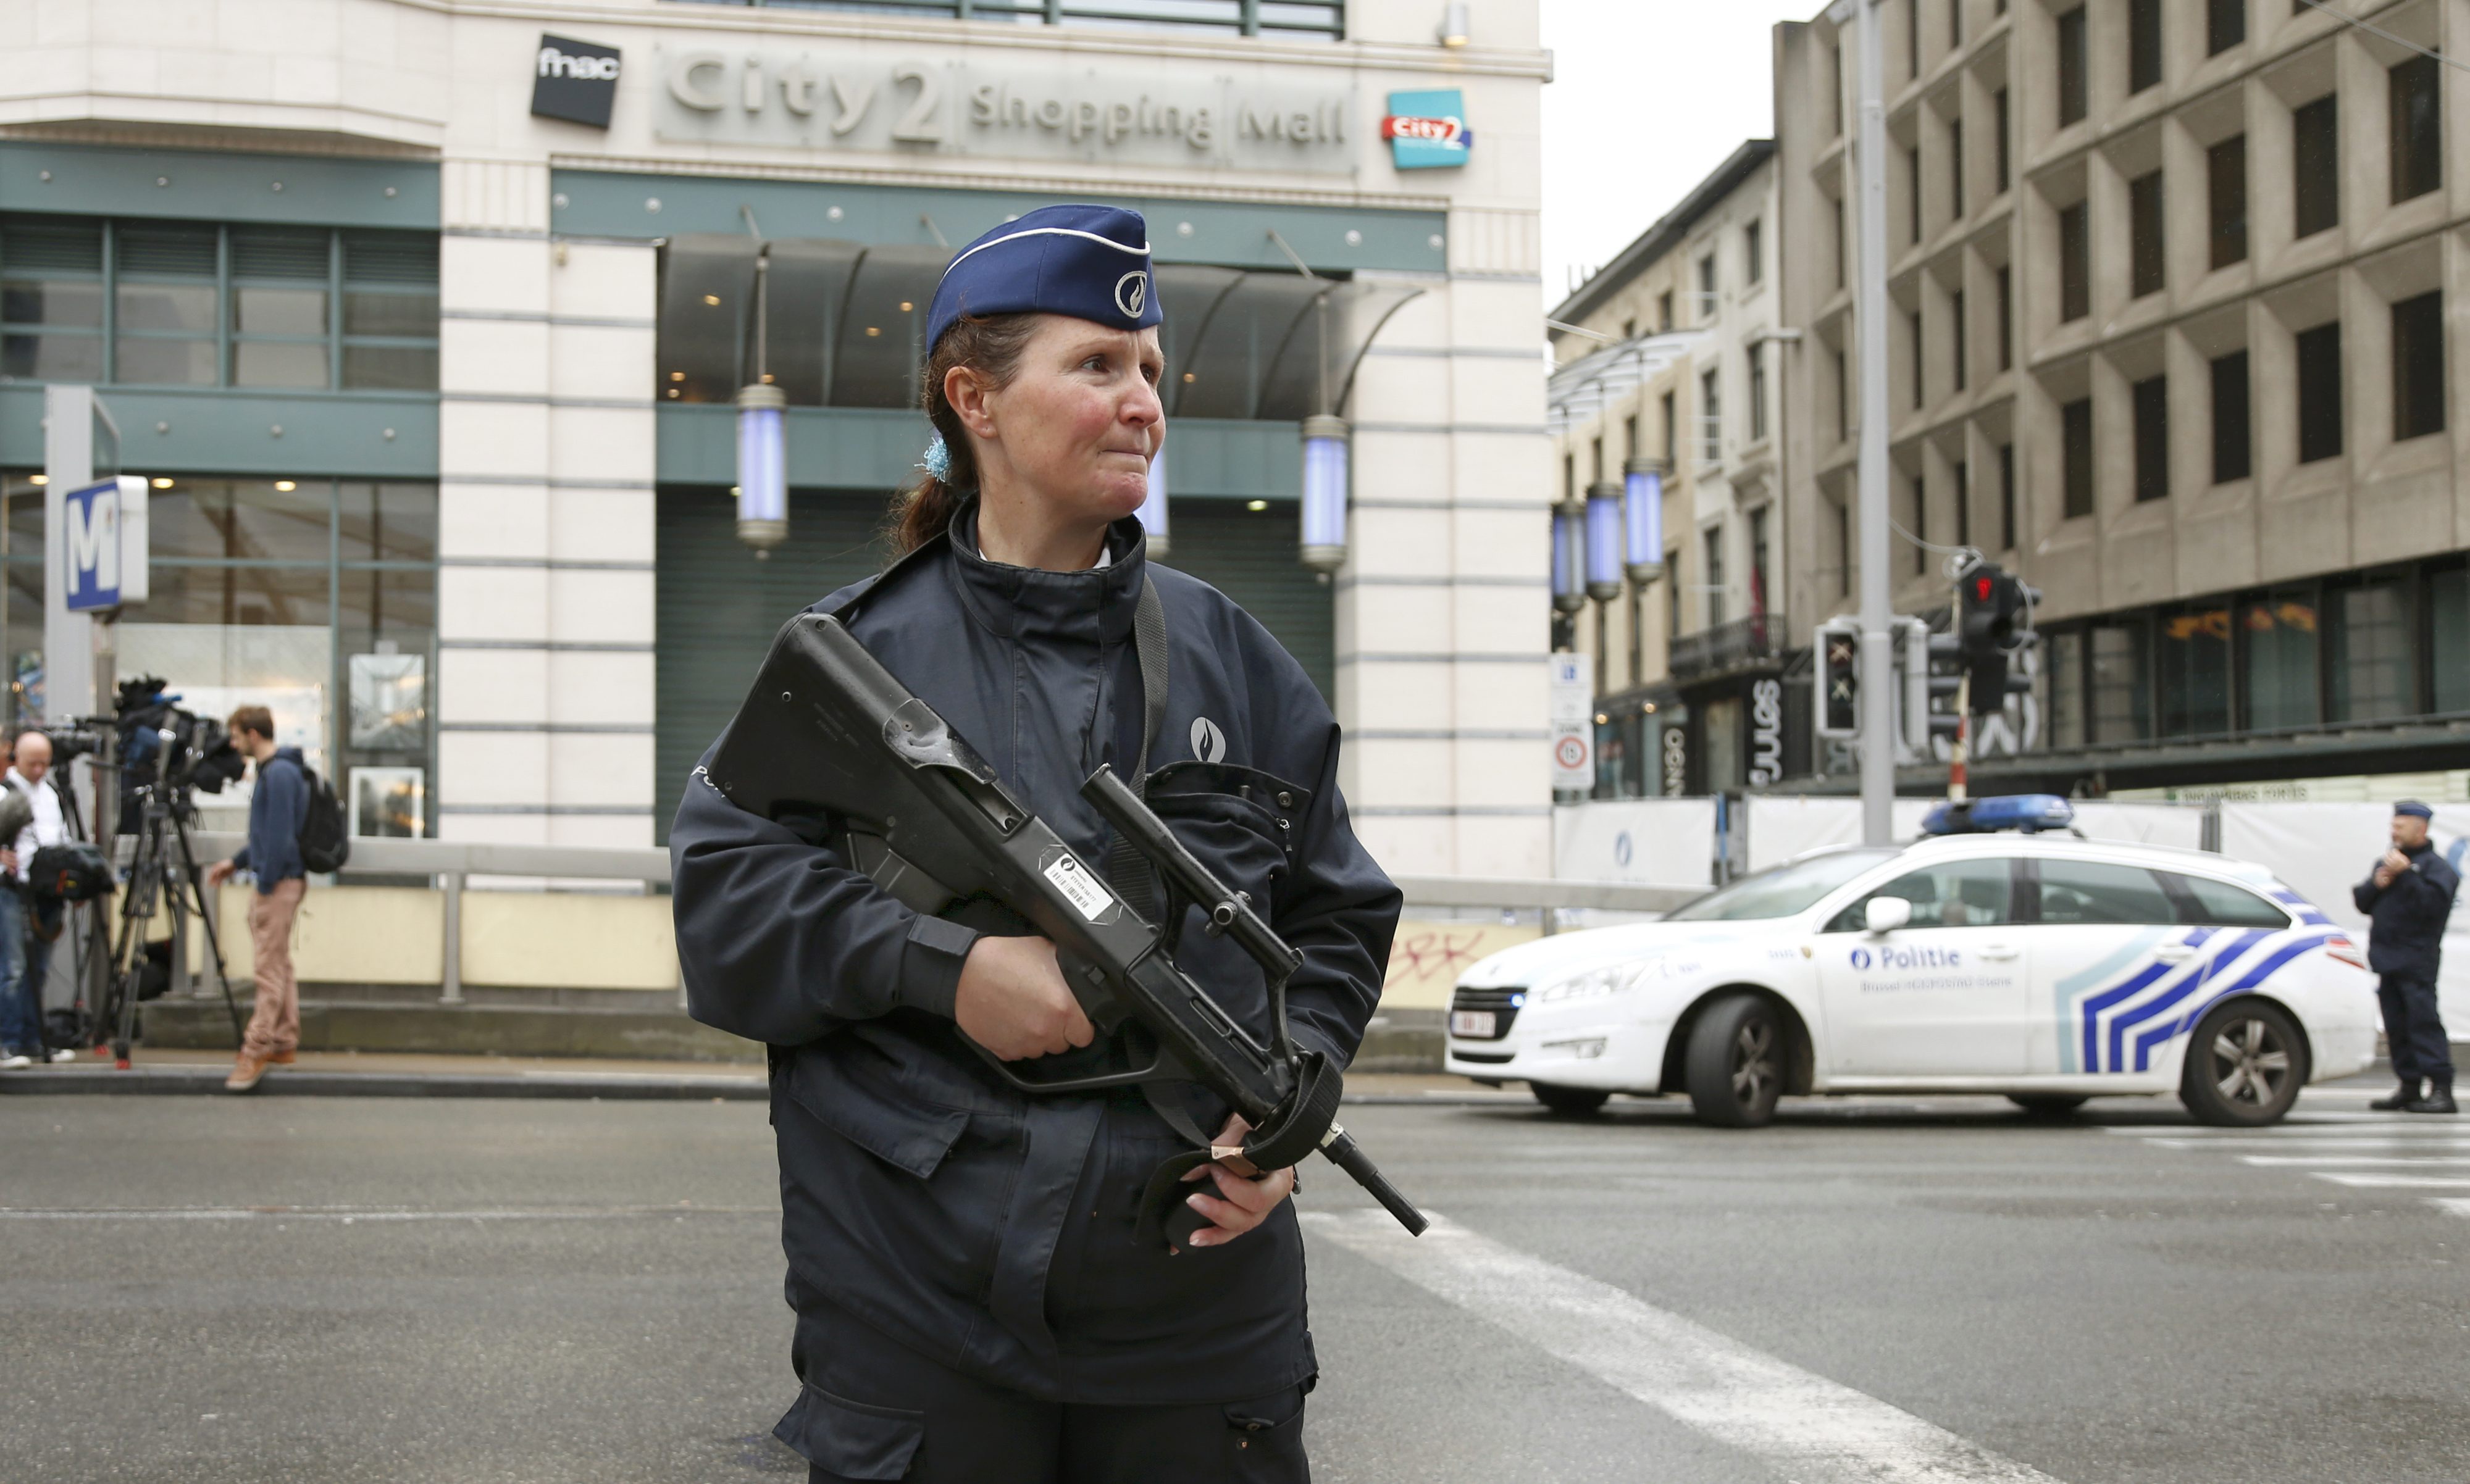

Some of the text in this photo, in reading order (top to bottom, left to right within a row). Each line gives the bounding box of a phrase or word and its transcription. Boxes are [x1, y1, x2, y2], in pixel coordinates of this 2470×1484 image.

[537, 47, 619, 80] fnac
[970, 84, 1214, 150] Shopping
[1238, 98, 1345, 143] Mall
[1392, 115, 1463, 150] City2
[67, 490, 117, 596] M
[1881, 945, 1960, 969] Politie
